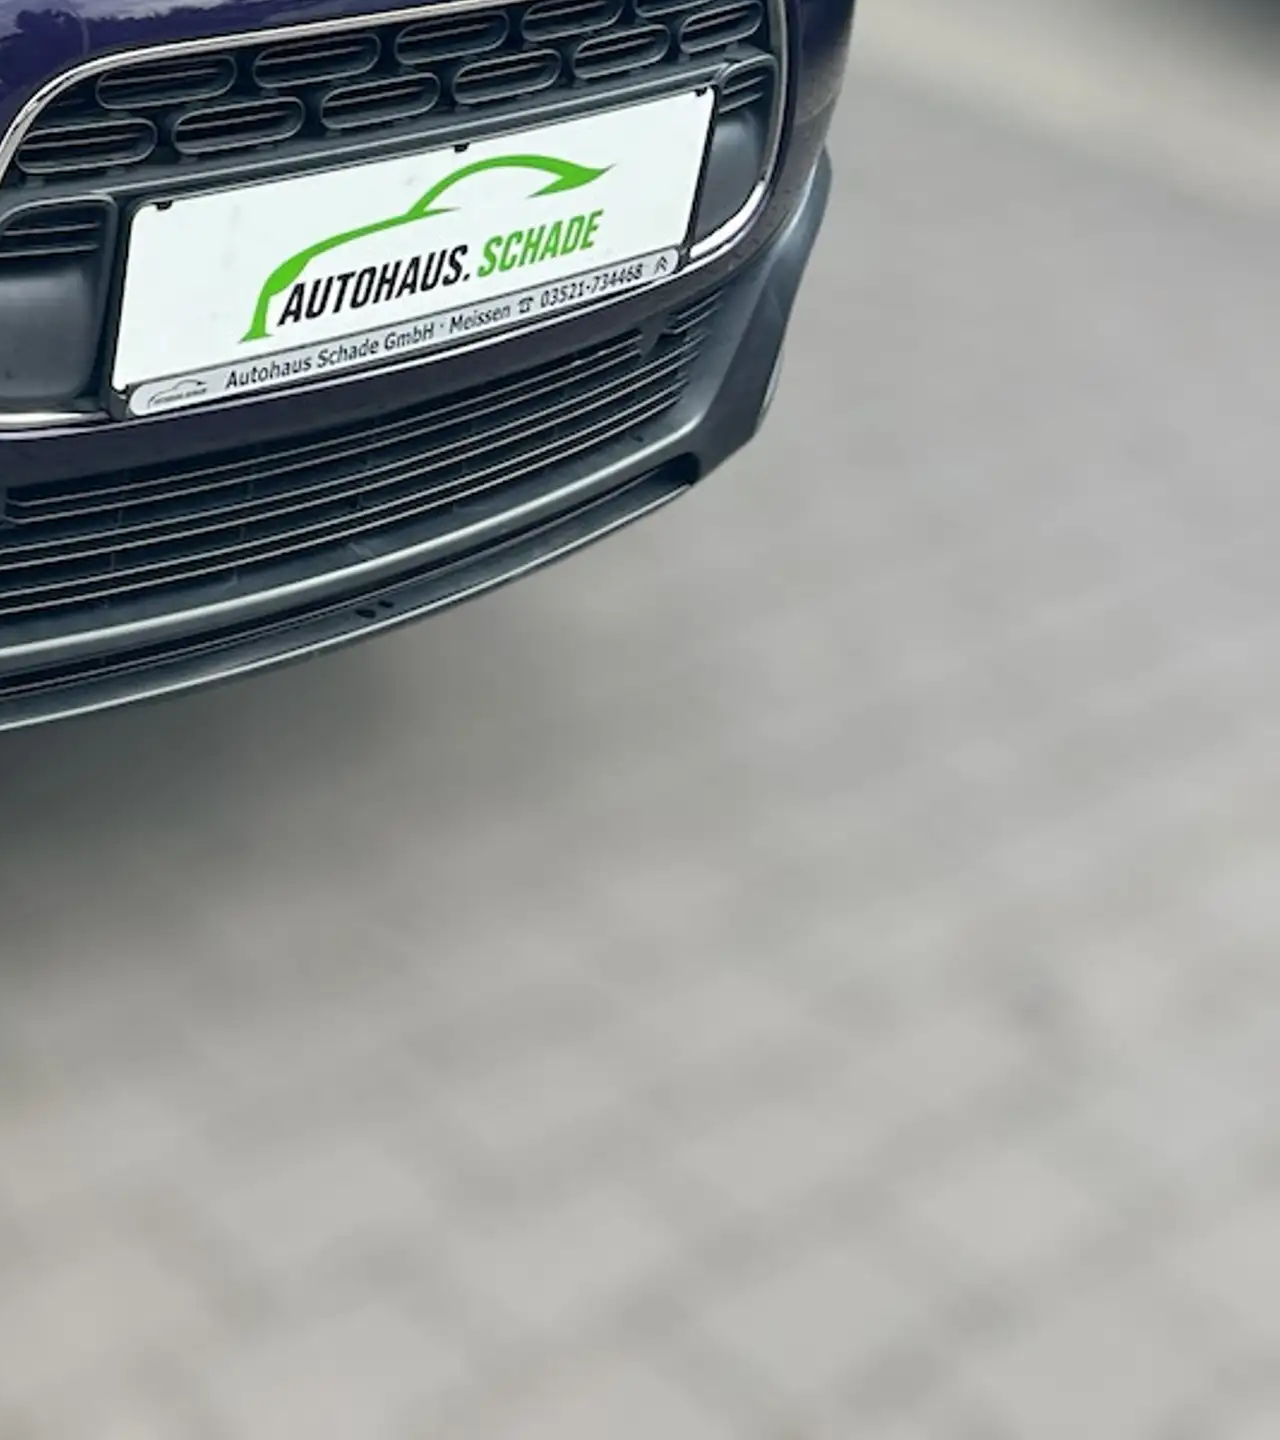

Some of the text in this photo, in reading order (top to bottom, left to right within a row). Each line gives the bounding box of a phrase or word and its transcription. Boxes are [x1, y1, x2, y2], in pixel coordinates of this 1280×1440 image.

[477, 209, 604, 278] SCHADE
[224, 356, 313, 390] Autohaus
[316, 337, 380, 368] Schade
[383, 322, 435, 352] GmbH
[449, 304, 511, 334] Meissen
